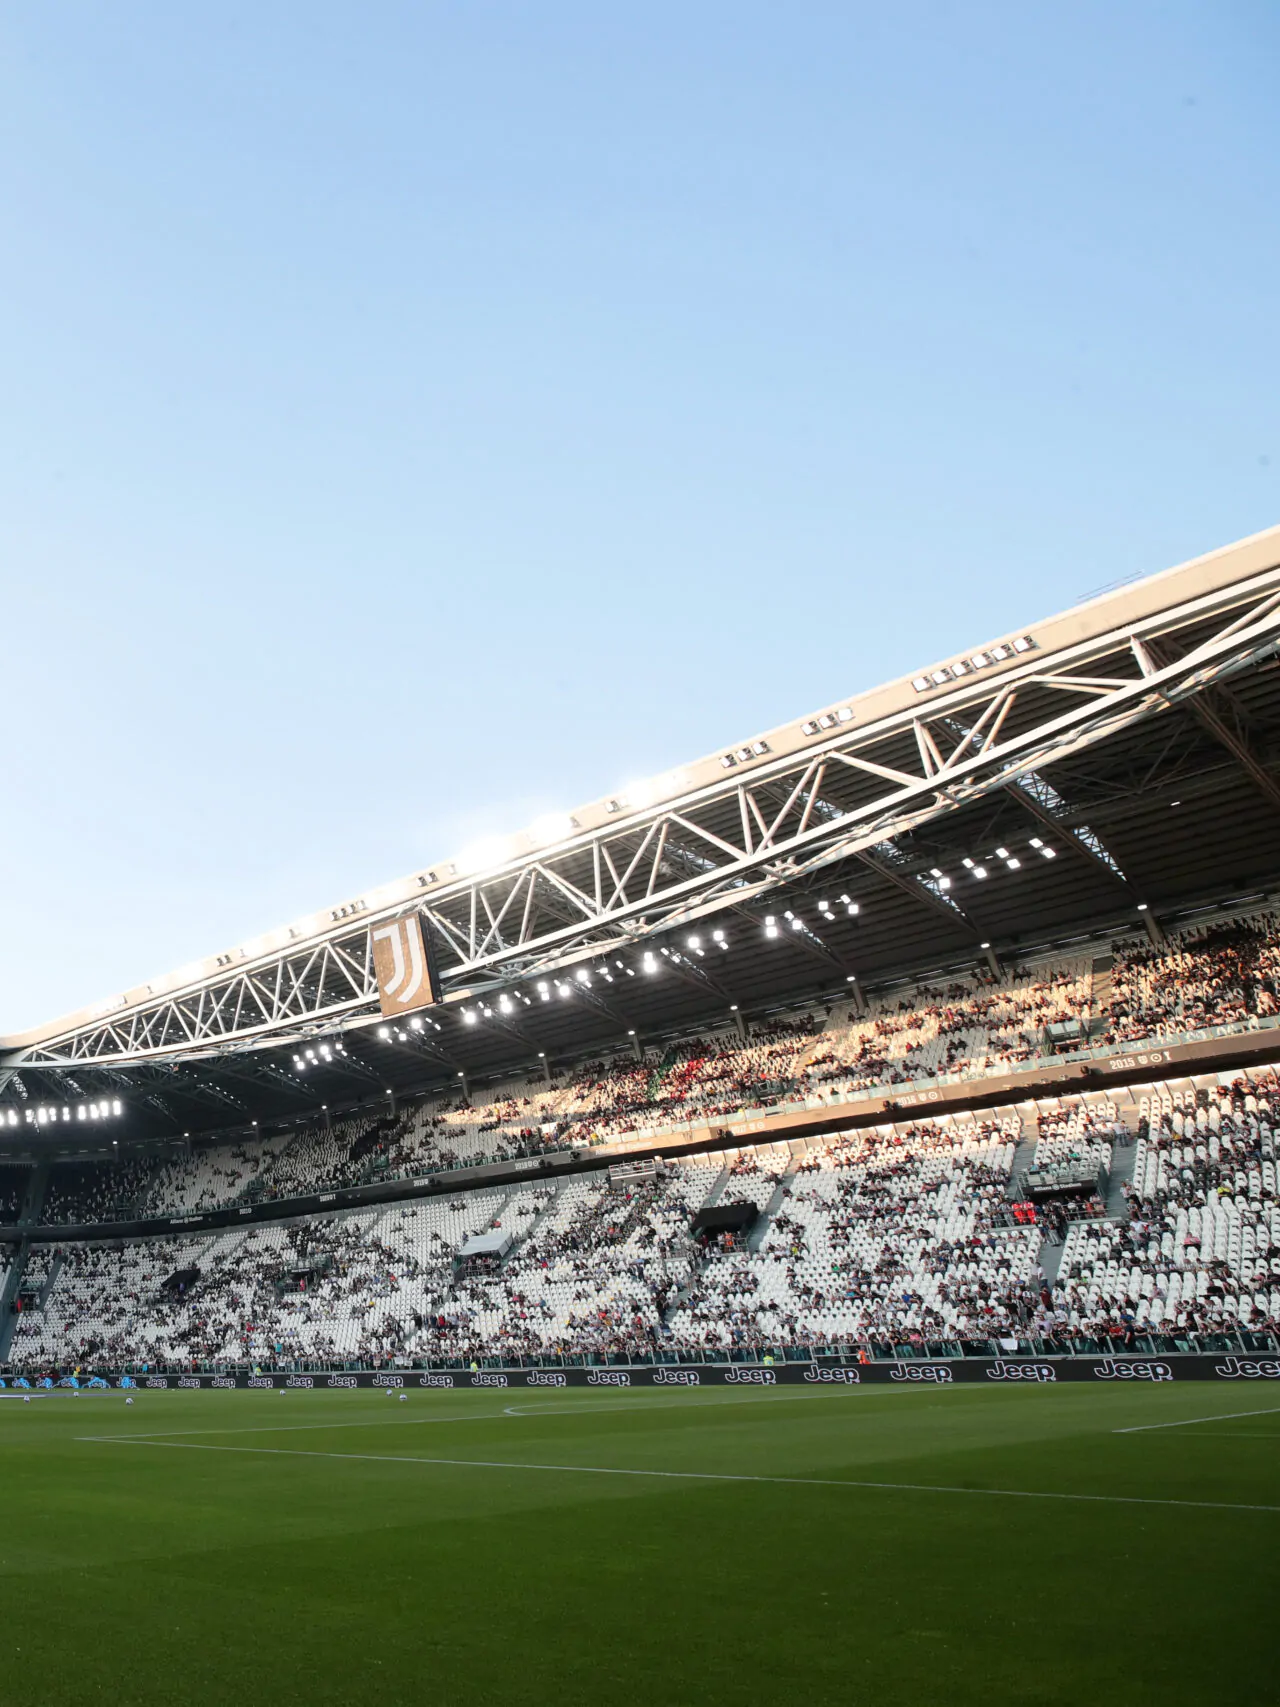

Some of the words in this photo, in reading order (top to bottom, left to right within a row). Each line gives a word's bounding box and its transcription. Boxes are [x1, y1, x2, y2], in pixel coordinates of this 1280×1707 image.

[1109, 1057, 1135, 1070] 2015
[725, 1366, 776, 1385] Jeep
[804, 1365, 860, 1385] Jeep
[890, 1363, 953, 1384] Jeep
[986, 1360, 1056, 1383] Jeep
[1093, 1358, 1174, 1384] Jeep
[1215, 1356, 1280, 1378] Jee
[146, 1377, 167, 1389] Jeep
[178, 1377, 201, 1389] Jeep
[211, 1377, 236, 1390] Jeep
[248, 1375, 273, 1389] Jeep
[286, 1374, 314, 1389] Jeep
[327, 1374, 358, 1389] Jeep
[372, 1373, 404, 1388] Jeep
[420, 1372, 454, 1388] Jeep
[471, 1371, 508, 1388] Jeep
[527, 1370, 567, 1387] Jeep
[587, 1369, 631, 1387] Jeep
[653, 1367, 699, 1386] Jeep
